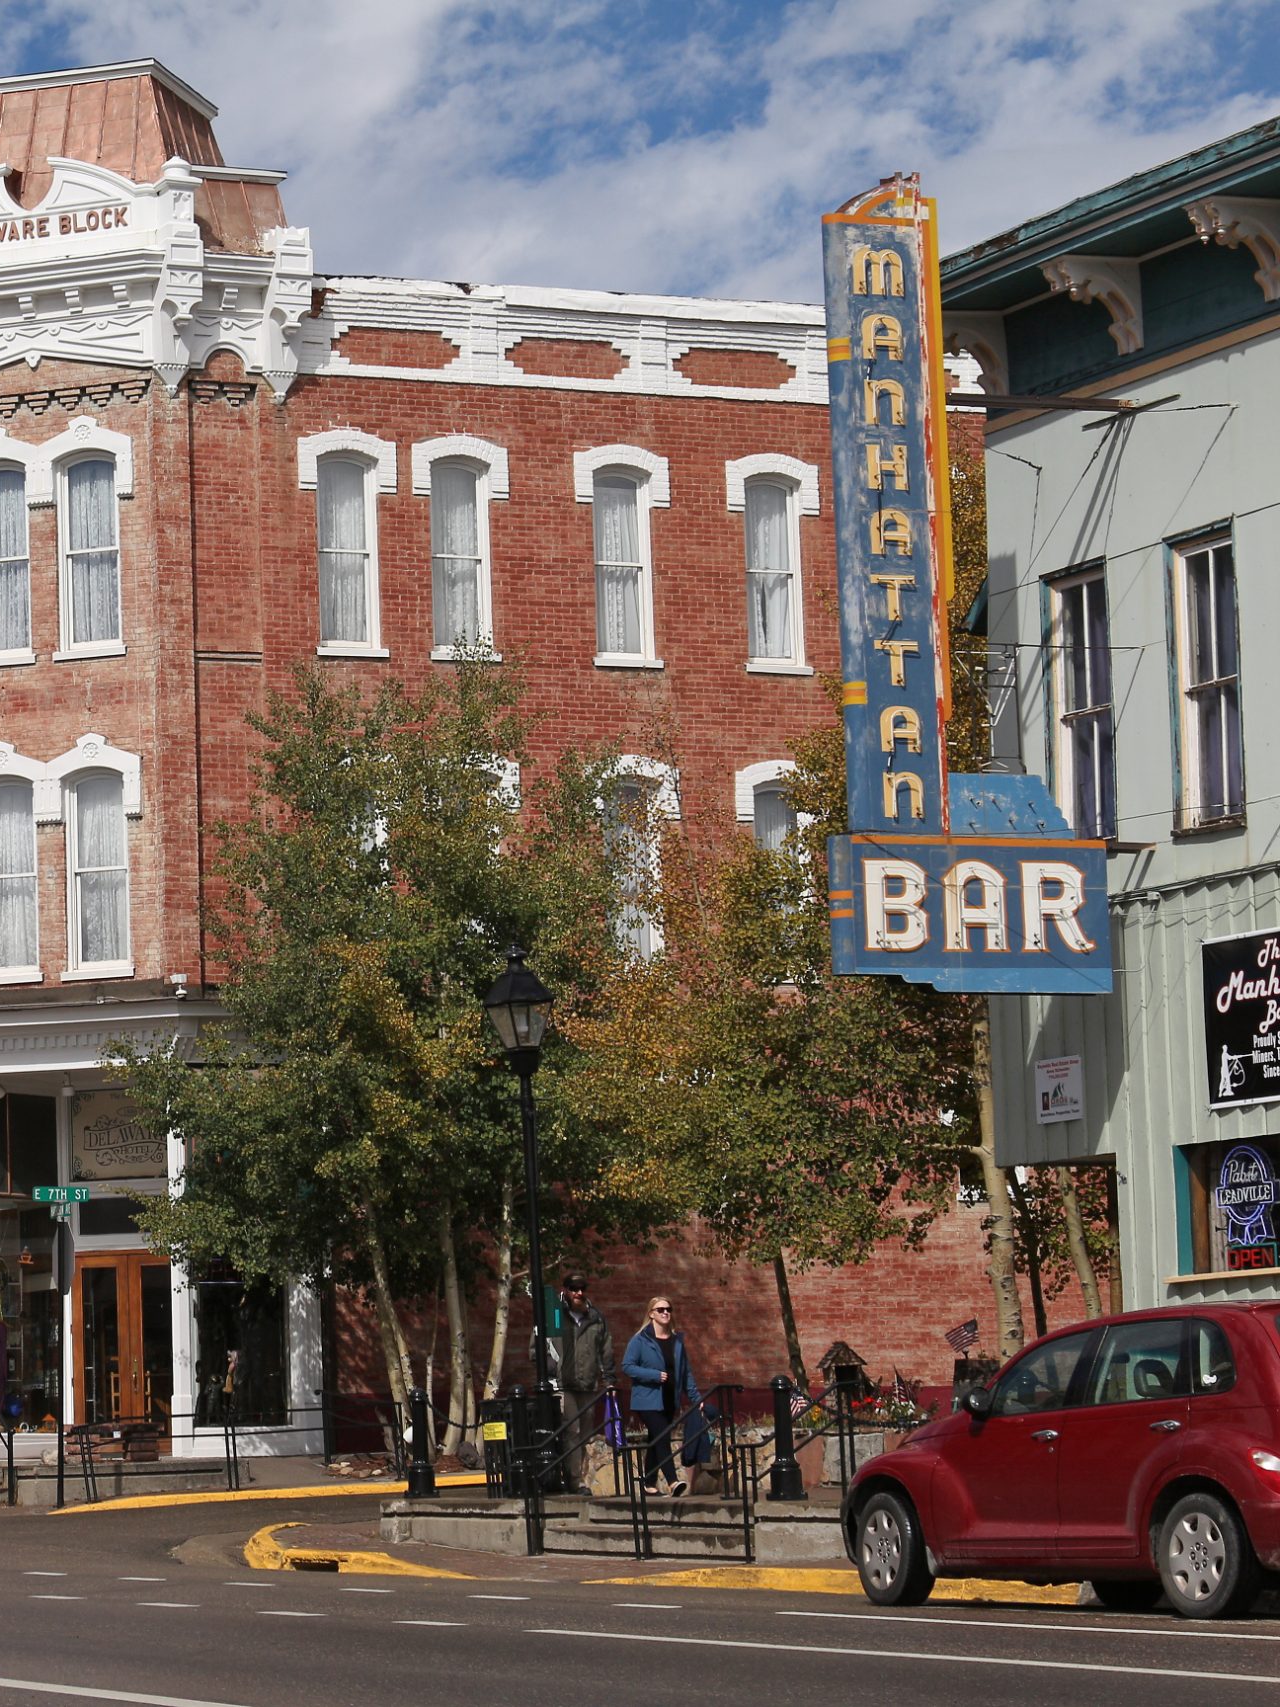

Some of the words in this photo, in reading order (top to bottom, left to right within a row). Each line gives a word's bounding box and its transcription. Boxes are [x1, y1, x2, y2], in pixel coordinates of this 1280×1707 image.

[58, 206, 129, 235] BLOCK
[861, 857, 1097, 953] BAR
[1252, 1032, 1277, 1049] Proudly
[1251, 1048, 1276, 1065] Miners,
[1226, 1159, 1258, 1184] Pabst
[34, 1188, 41, 1200] E
[48, 1188, 68, 1200] 7TH
[74, 1188, 88, 1200] ST
[1219, 1184, 1271, 1206] LEADVILLE
[1227, 1247, 1275, 1270] OPEN
